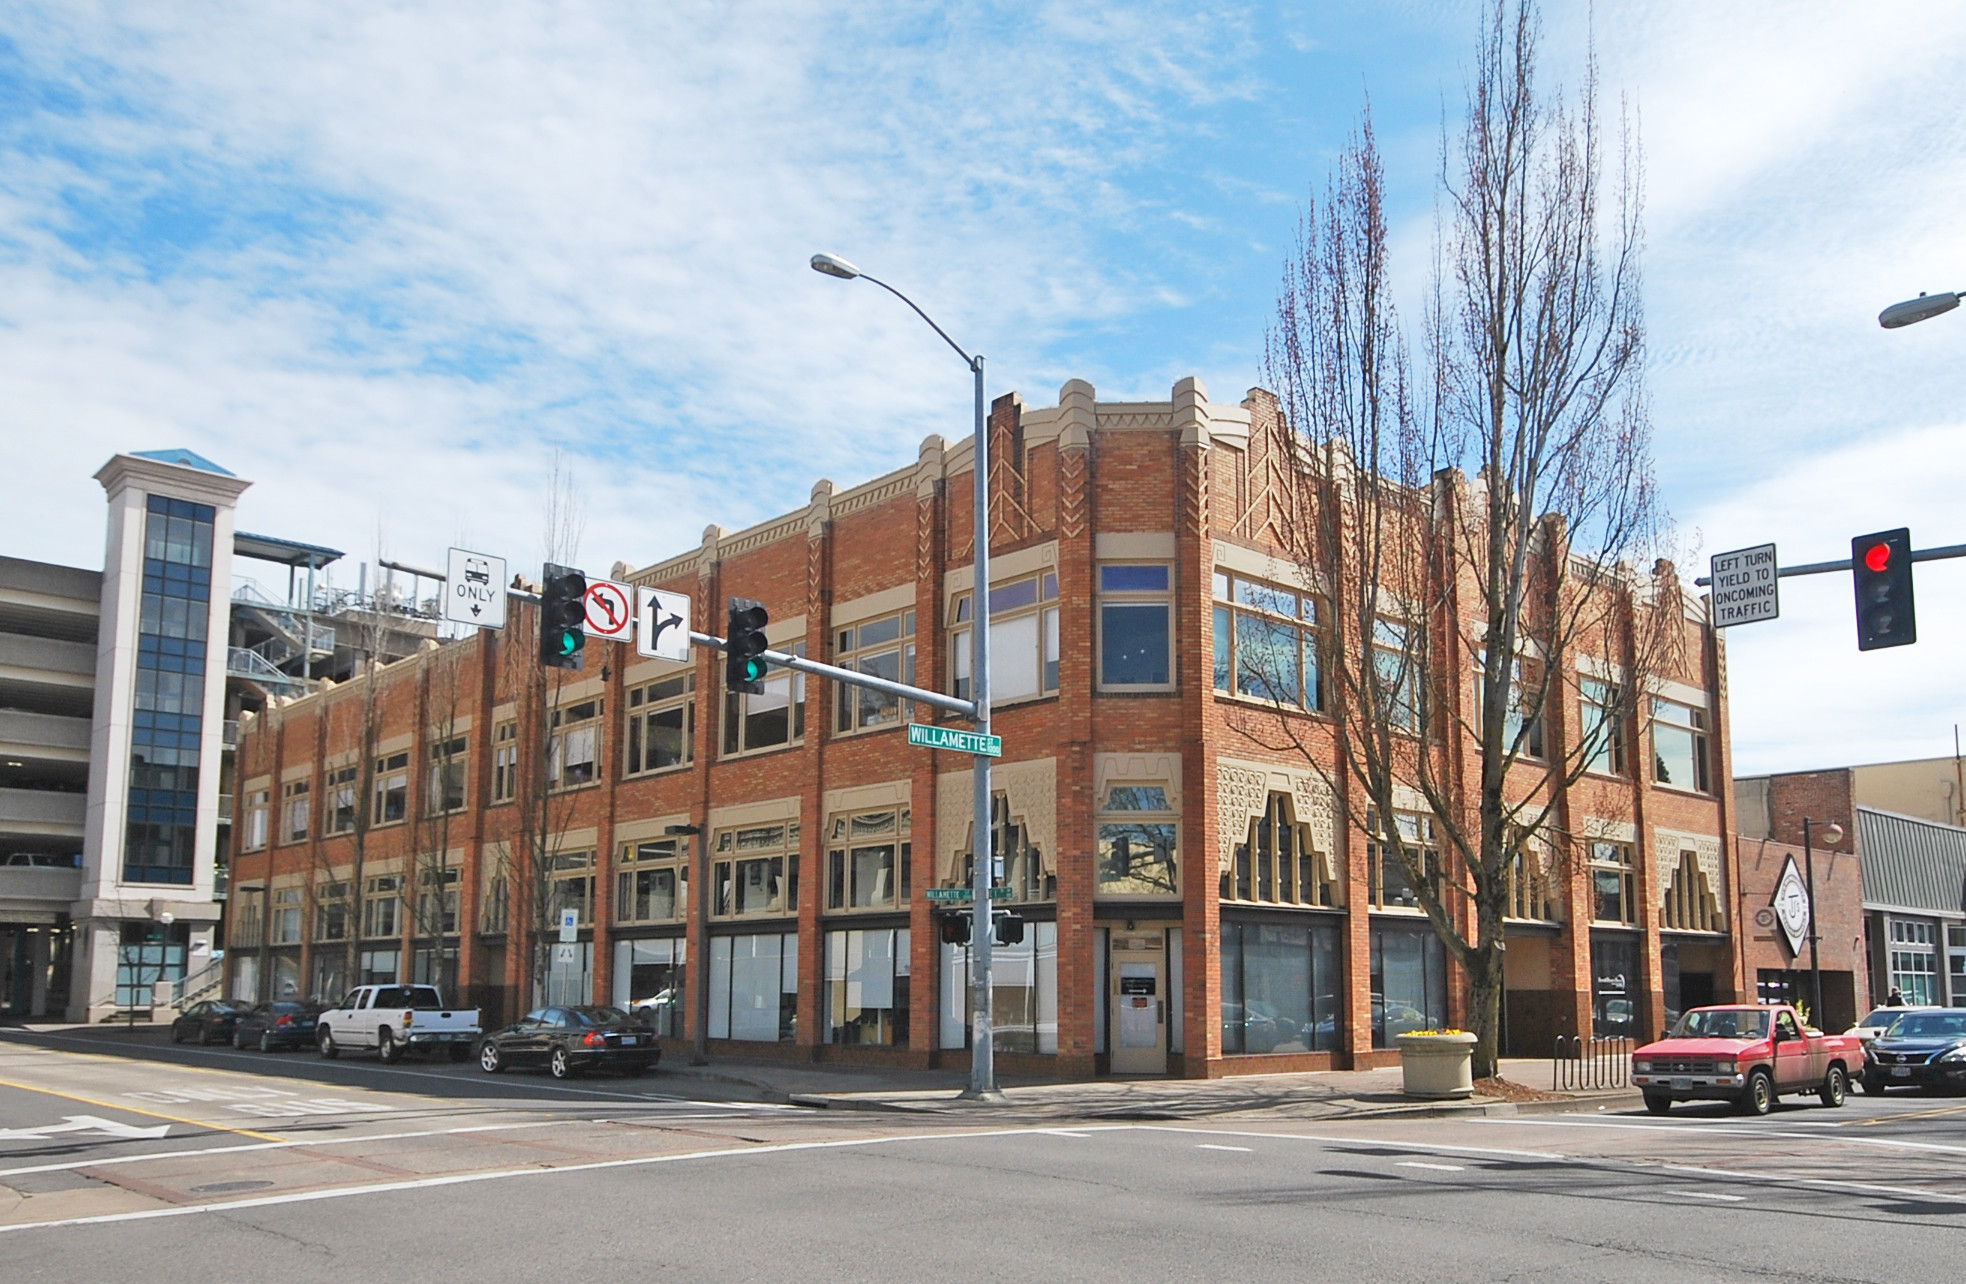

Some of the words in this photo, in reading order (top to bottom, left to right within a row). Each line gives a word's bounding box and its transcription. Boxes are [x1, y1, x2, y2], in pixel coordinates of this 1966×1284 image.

[1715, 557, 1739, 573] LEFT
[1744, 551, 1772, 566] TURN
[1719, 571, 1750, 588] YIELD
[1756, 568, 1769, 581] TO
[457, 584, 495, 603] ONLY
[1716, 583, 1774, 605] ONCOMING
[1721, 601, 1771, 620] TRAFFIC
[911, 726, 987, 752] WILLAMETTE
[121, 1085, 299, 1104] ONLY
[221, 1098, 394, 1117] BUS
